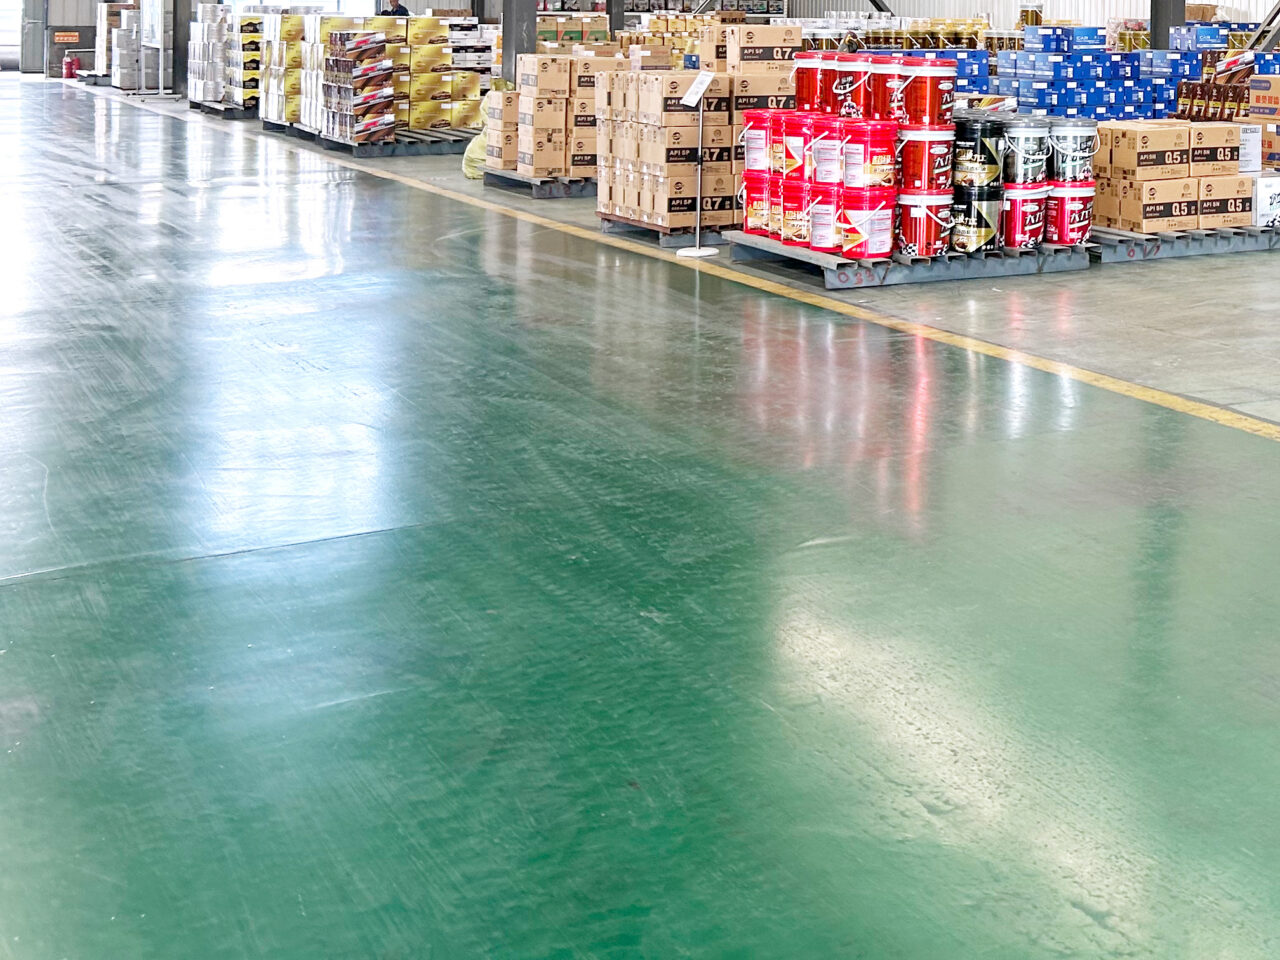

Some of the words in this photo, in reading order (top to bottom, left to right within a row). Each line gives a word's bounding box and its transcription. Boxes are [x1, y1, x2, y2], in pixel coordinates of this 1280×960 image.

[773, 48, 792, 59] Q7
[768, 96, 787, 108] Q7
[1165, 152, 1180, 164] Q5
[1217, 148, 1230, 160] Q5
[703, 198, 722, 210] Q7
[1172, 203, 1187, 215] Q5
[1227, 199, 1243, 212] Q5
